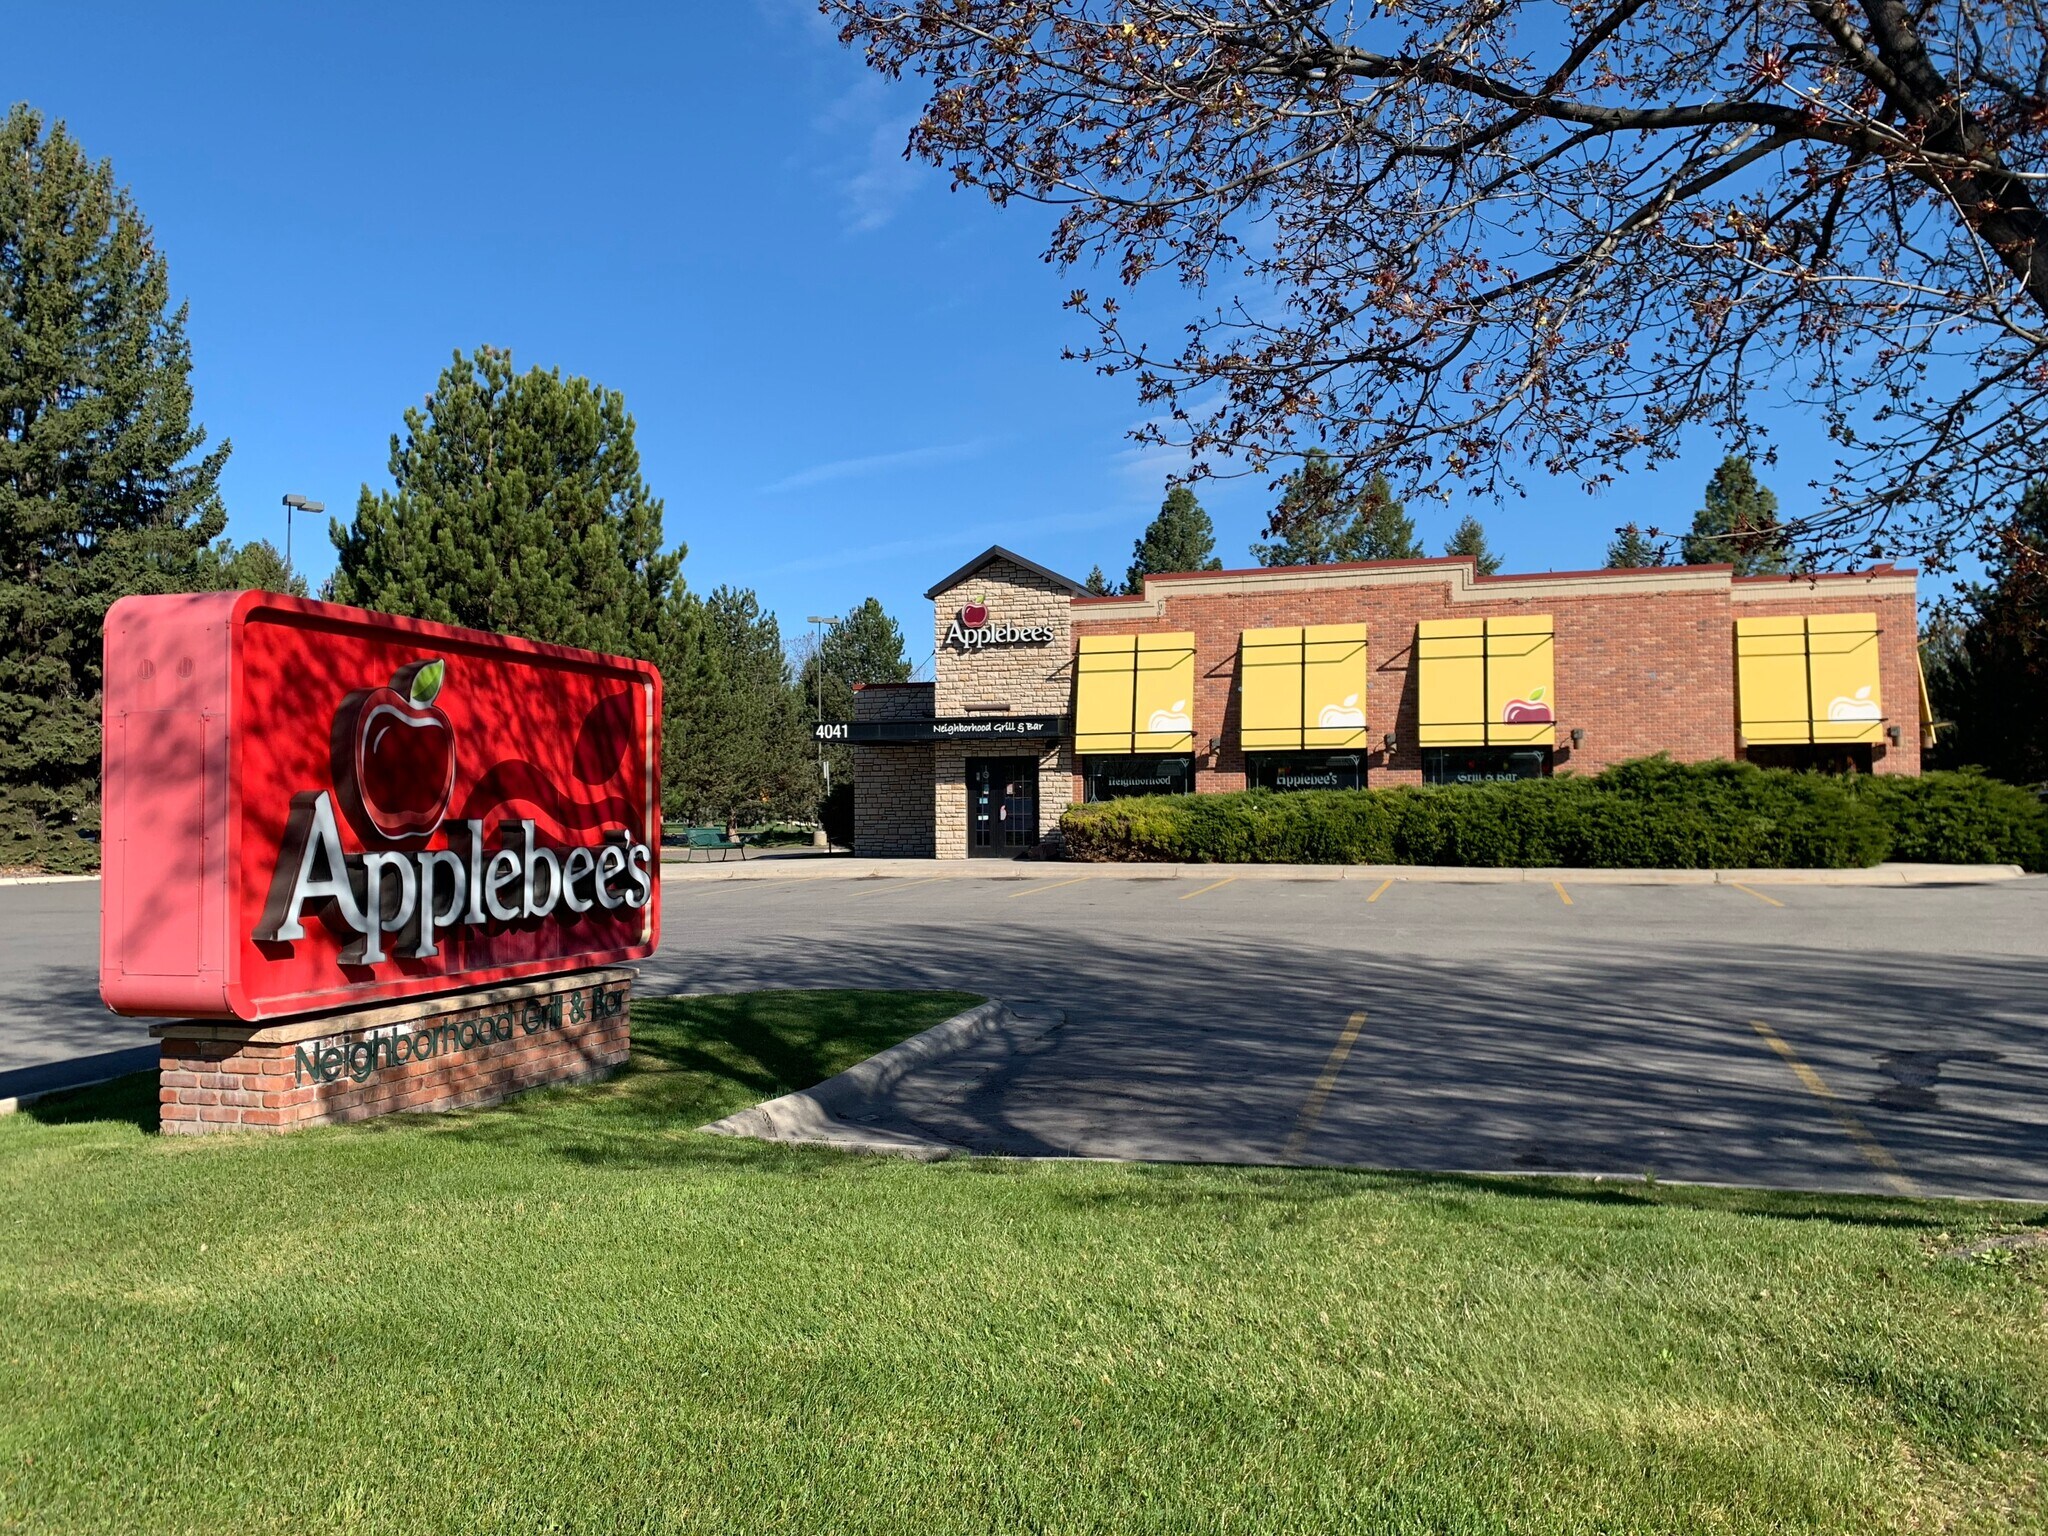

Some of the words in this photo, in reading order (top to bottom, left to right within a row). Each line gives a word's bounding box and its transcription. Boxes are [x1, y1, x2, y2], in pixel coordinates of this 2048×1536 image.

[815, 724, 848, 739] 4041
[933, 722, 992, 735] Neighborhood
[993, 722, 1016, 733] Grill
[1025, 722, 1044, 731] Bar
[276, 790, 651, 965] Applebee's
[295, 1003, 513, 1088] Neighborhood
[522, 995, 563, 1035] Grill
[570, 990, 586, 1024] &
[592, 986, 624, 1021] Bar
